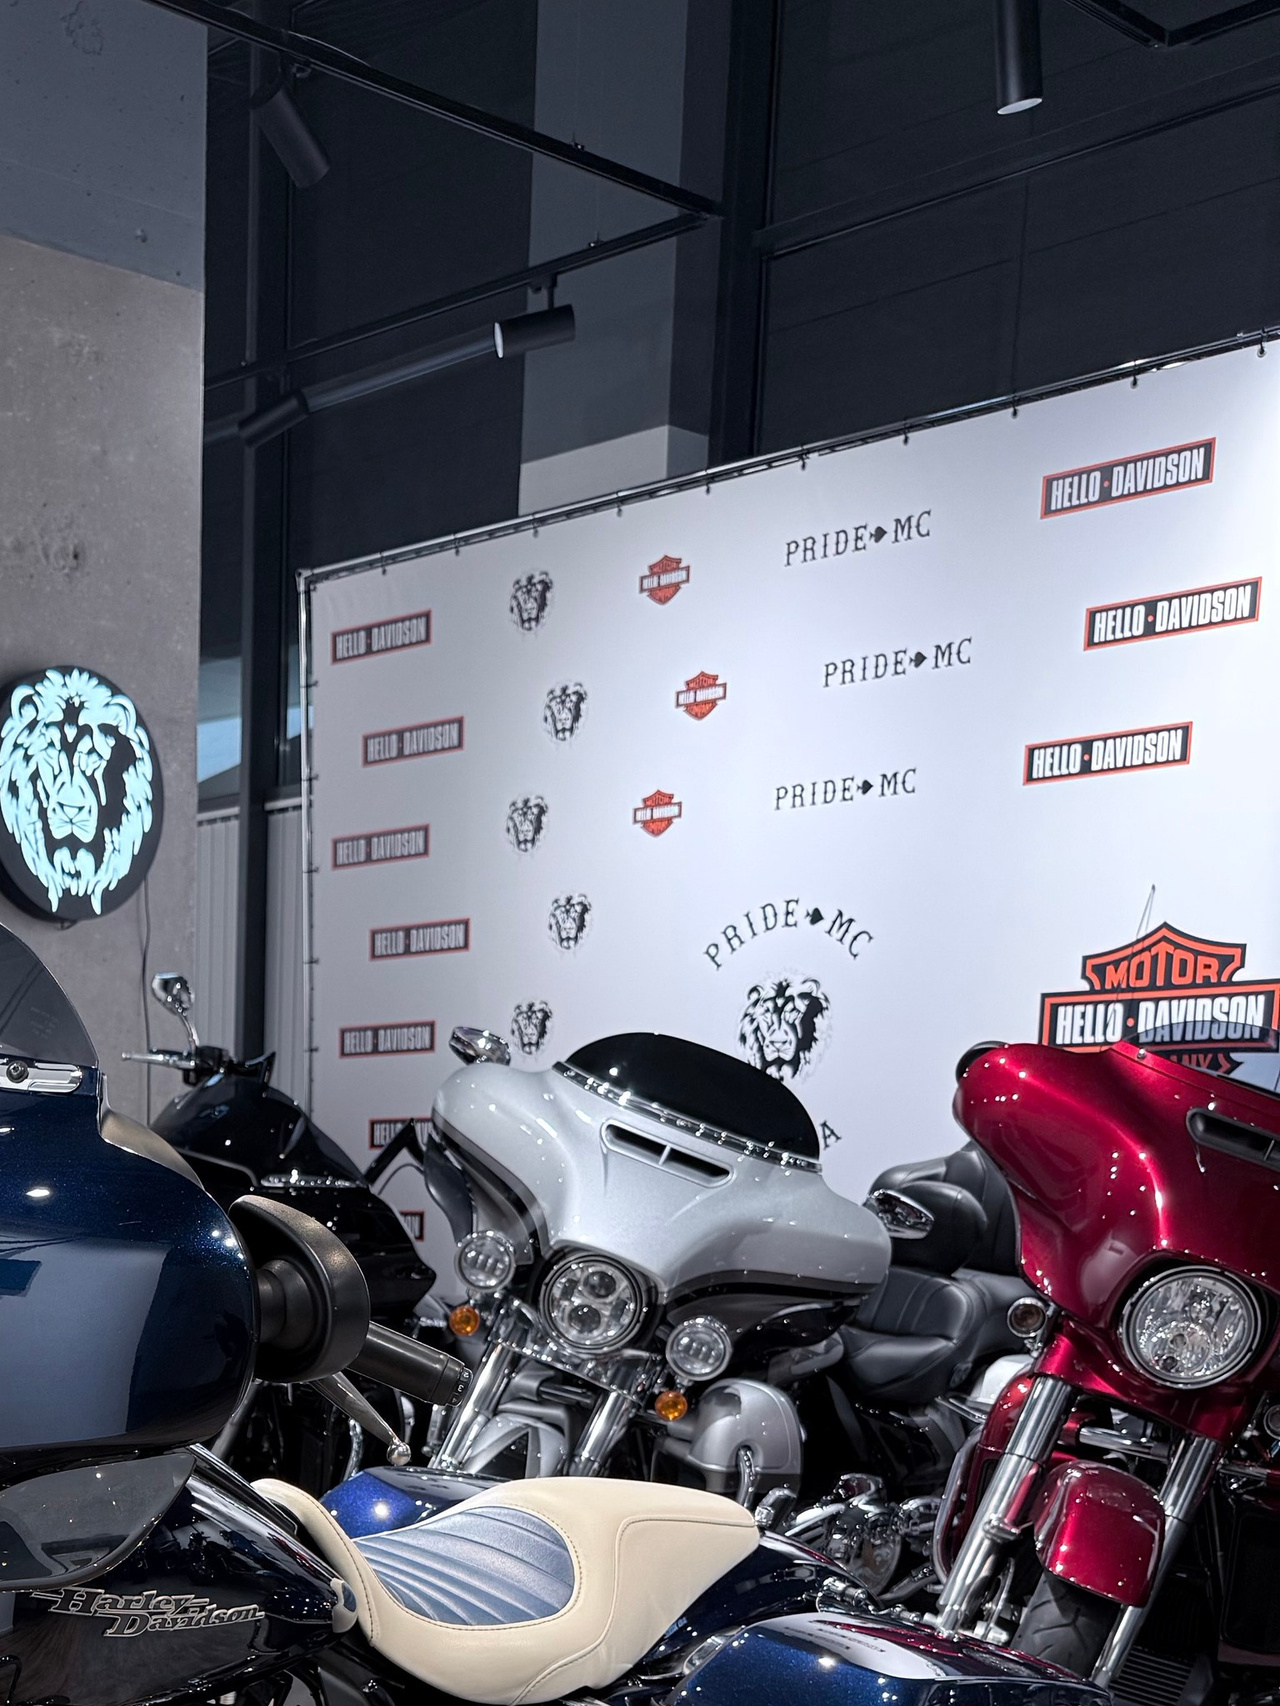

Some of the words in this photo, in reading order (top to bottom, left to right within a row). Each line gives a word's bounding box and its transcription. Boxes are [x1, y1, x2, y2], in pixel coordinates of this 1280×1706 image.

[1051, 471, 1101, 511] HELLO
[1111, 447, 1205, 497] DAVIDSON
[784, 523, 868, 567] PRIDE
[891, 509, 932, 544] MC
[1093, 604, 1146, 643] HELLO
[1155, 585, 1252, 632] DAVIDSON
[823, 648, 908, 688] PRIDE
[932, 636, 972, 670] MC
[1032, 743, 1082, 779] HELLO
[1091, 729, 1183, 771] DAVIDSON
[774, 775, 855, 811] PRIDE
[879, 766, 917, 797] MC
[703, 897, 800, 971] PRIDE
[824, 908, 874, 960] MC
[1105, 941, 1219, 990] MOTOR
[1056, 1002, 1124, 1045] HELLO
[1137, 995, 1265, 1044] DAVIDSON
[103, 1604, 265, 1637] Davidson
